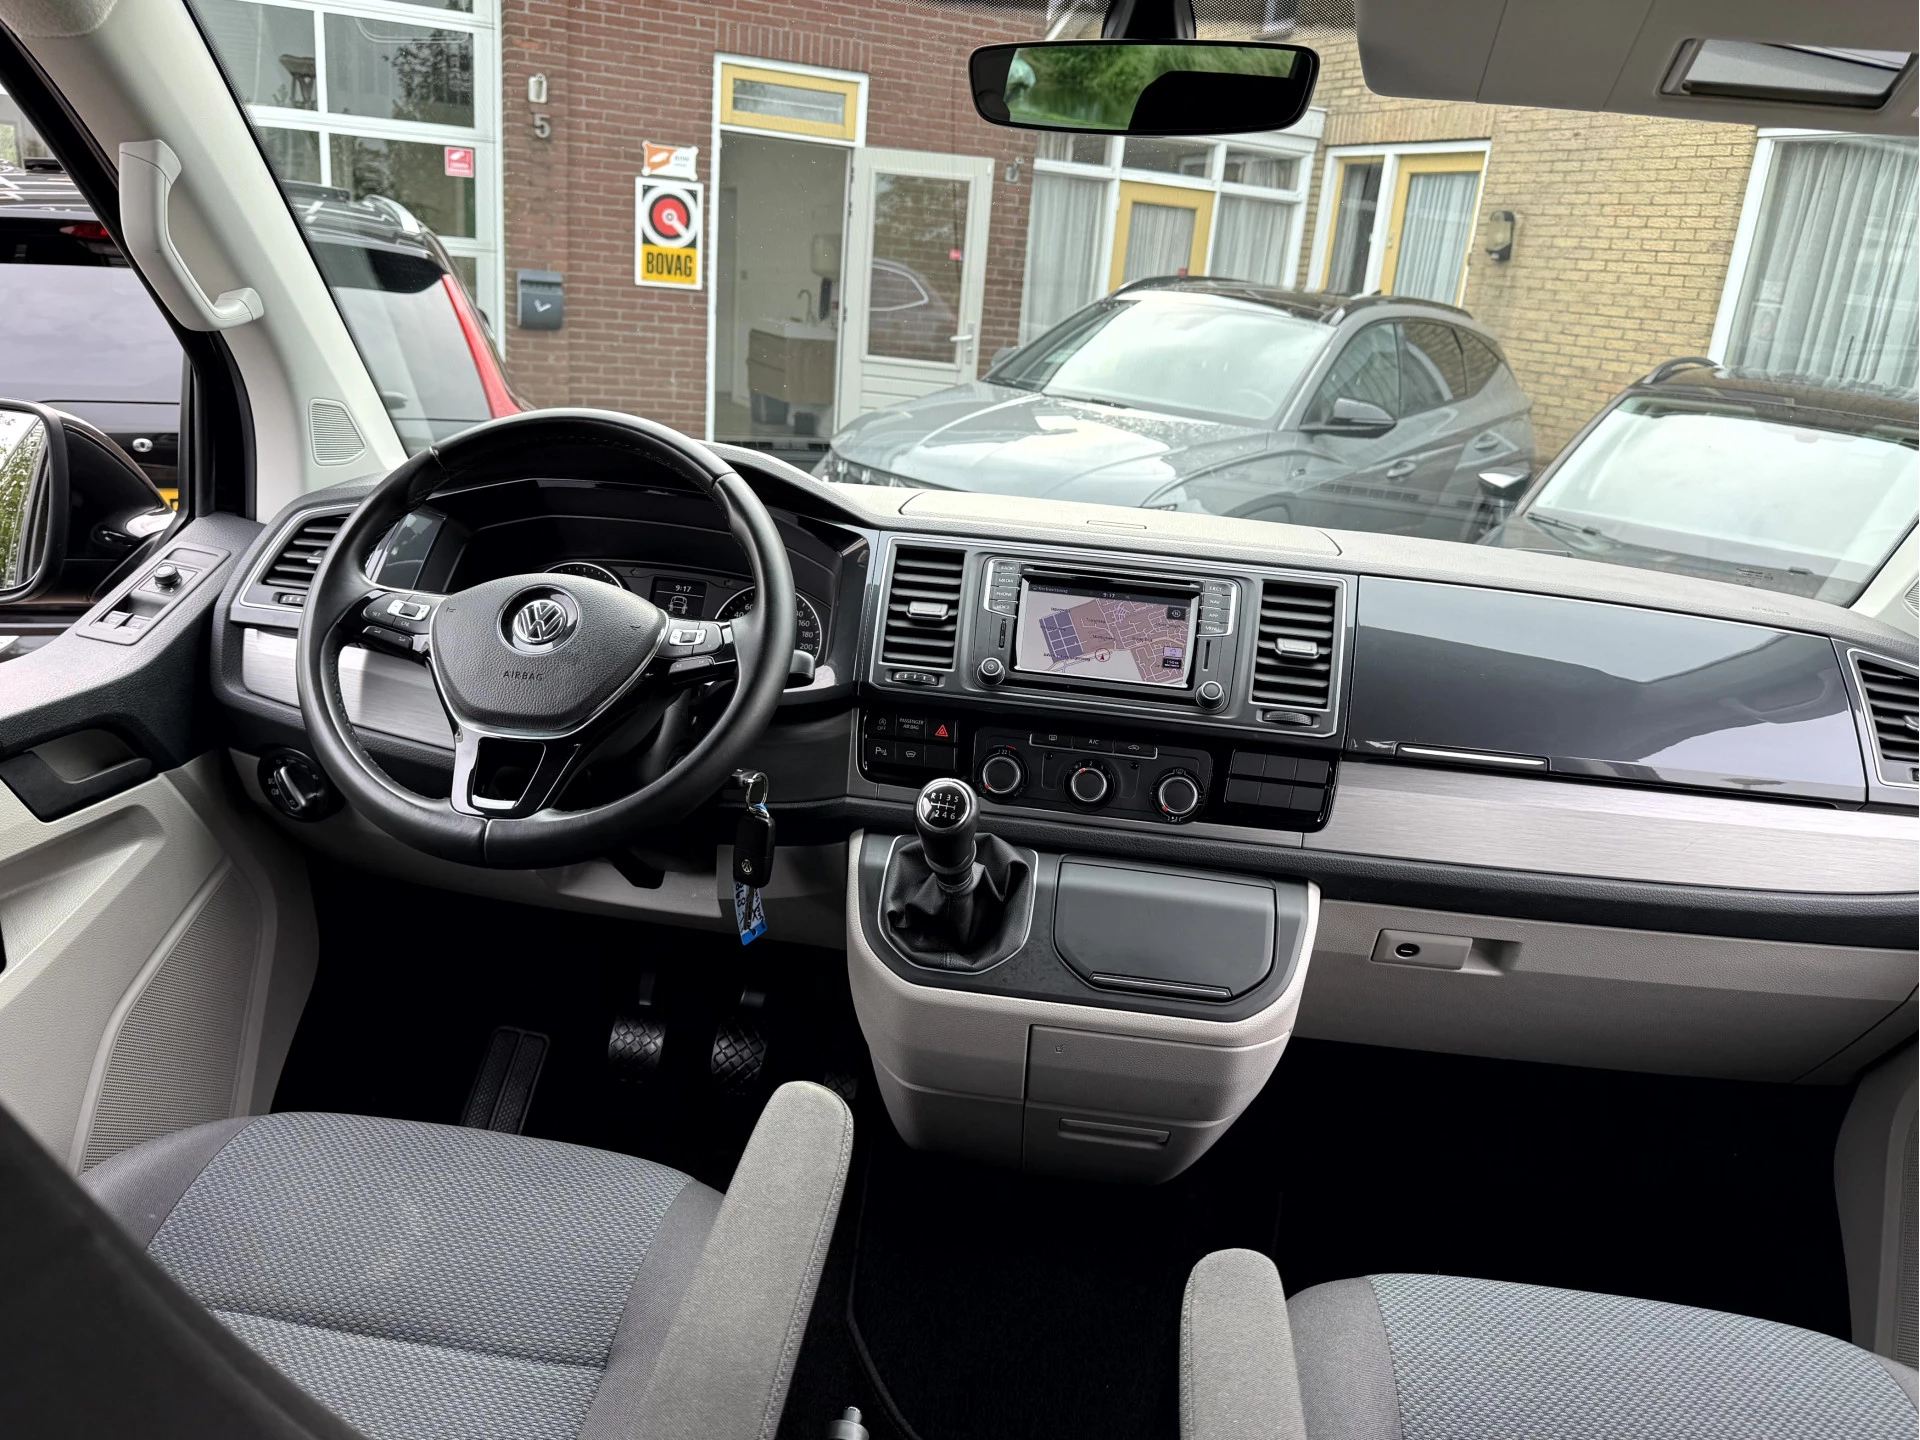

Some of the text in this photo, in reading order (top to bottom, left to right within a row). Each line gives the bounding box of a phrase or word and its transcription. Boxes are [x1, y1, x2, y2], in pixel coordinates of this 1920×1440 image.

[534, 113, 551, 138] 5
[646, 251, 693, 277] BOVAG
[675, 584, 692, 593] 9:17
[798, 619, 810, 627] 160
[801, 630, 814, 638] 180
[799, 642, 814, 651] 200
[502, 670, 543, 681] AIRBAG
[930, 792, 937, 800] R
[953, 795, 959, 803] 5
[934, 809, 940, 818] 2
[950, 812, 956, 820] 6
